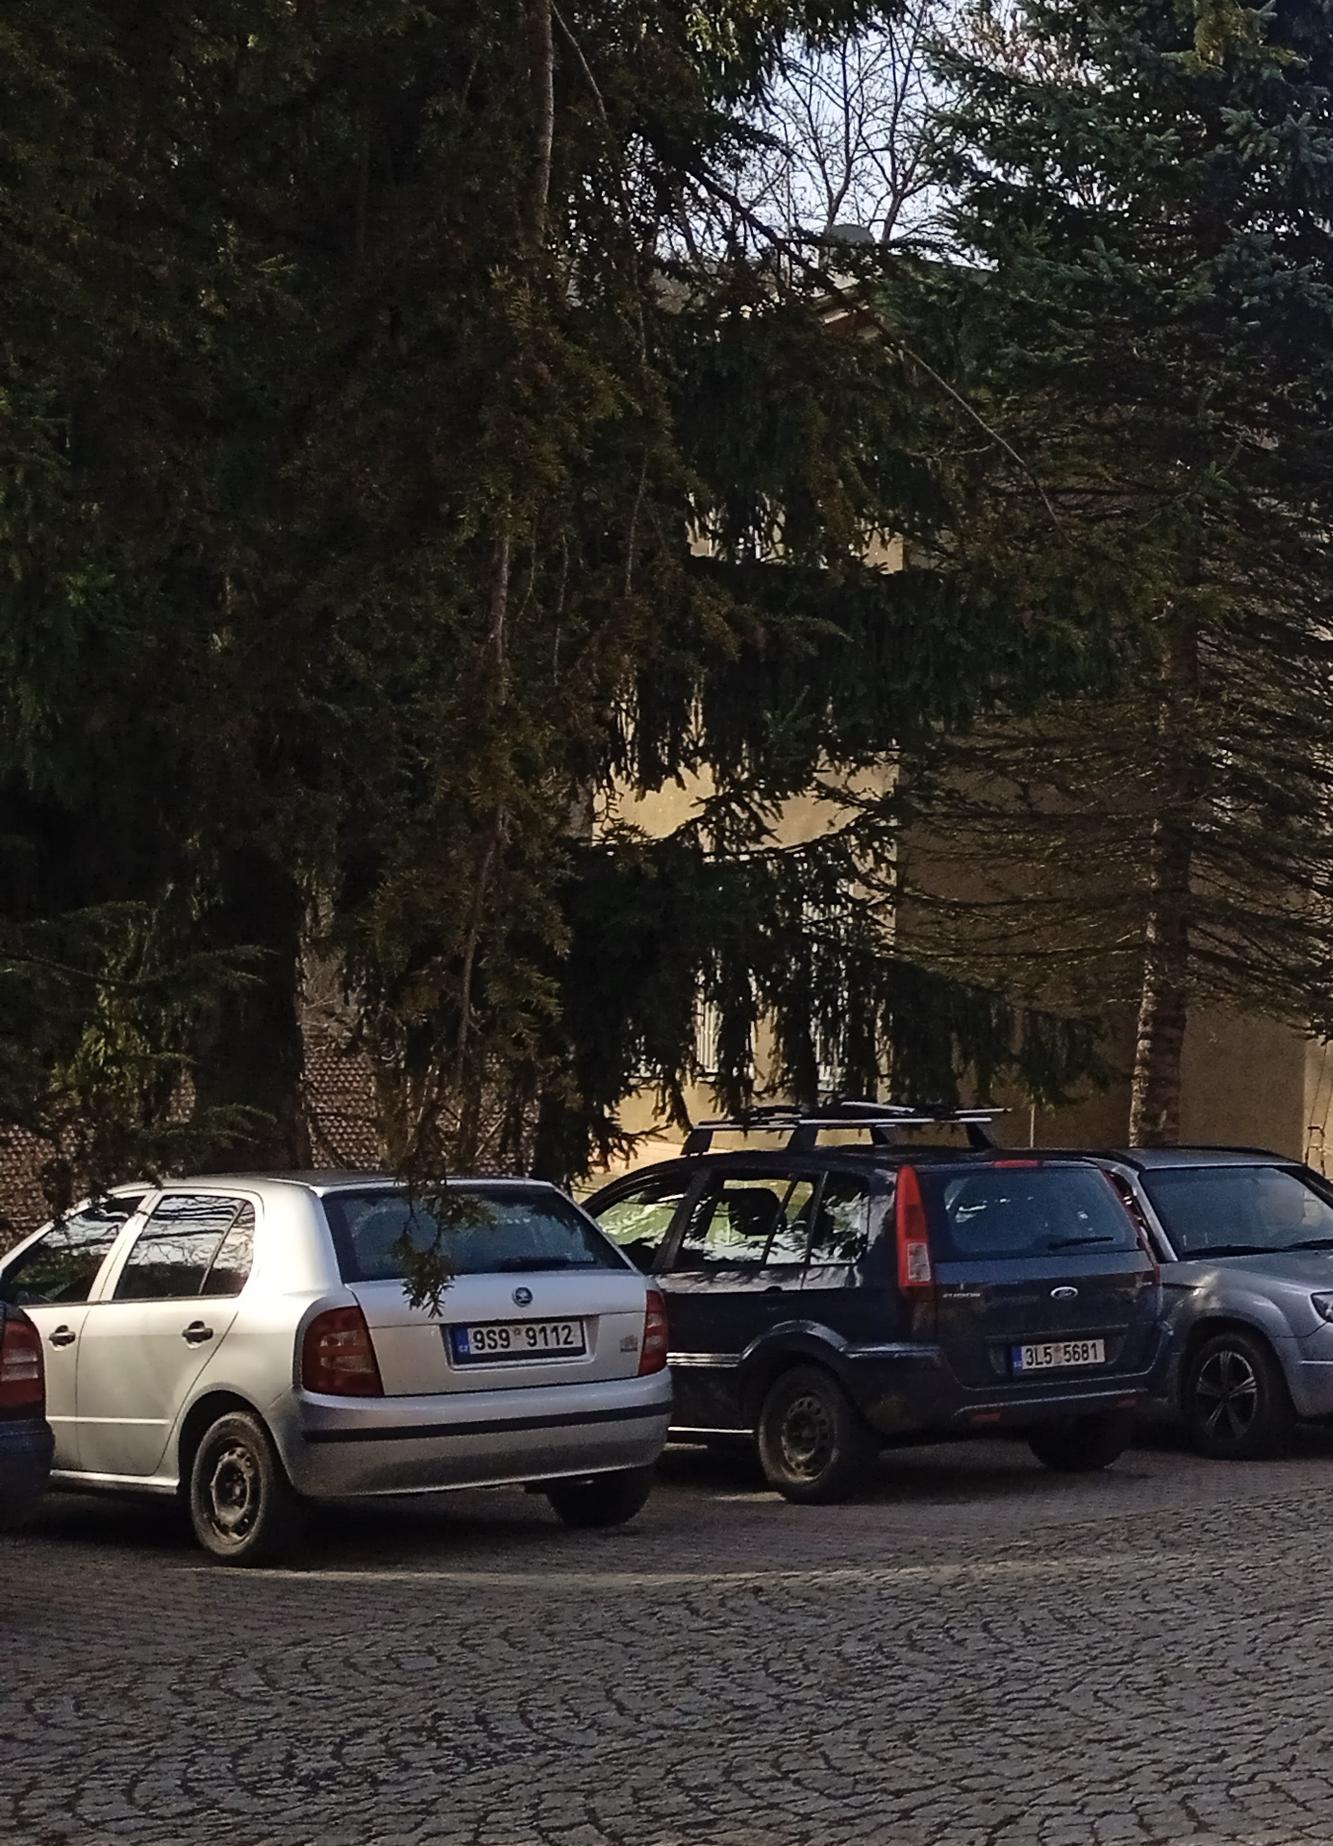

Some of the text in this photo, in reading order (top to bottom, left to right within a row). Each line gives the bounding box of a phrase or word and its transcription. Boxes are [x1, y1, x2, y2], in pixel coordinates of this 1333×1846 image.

[473, 1324, 573, 1351] 9S9 9112
[1025, 1342, 1098, 1366] 3L5 5681
